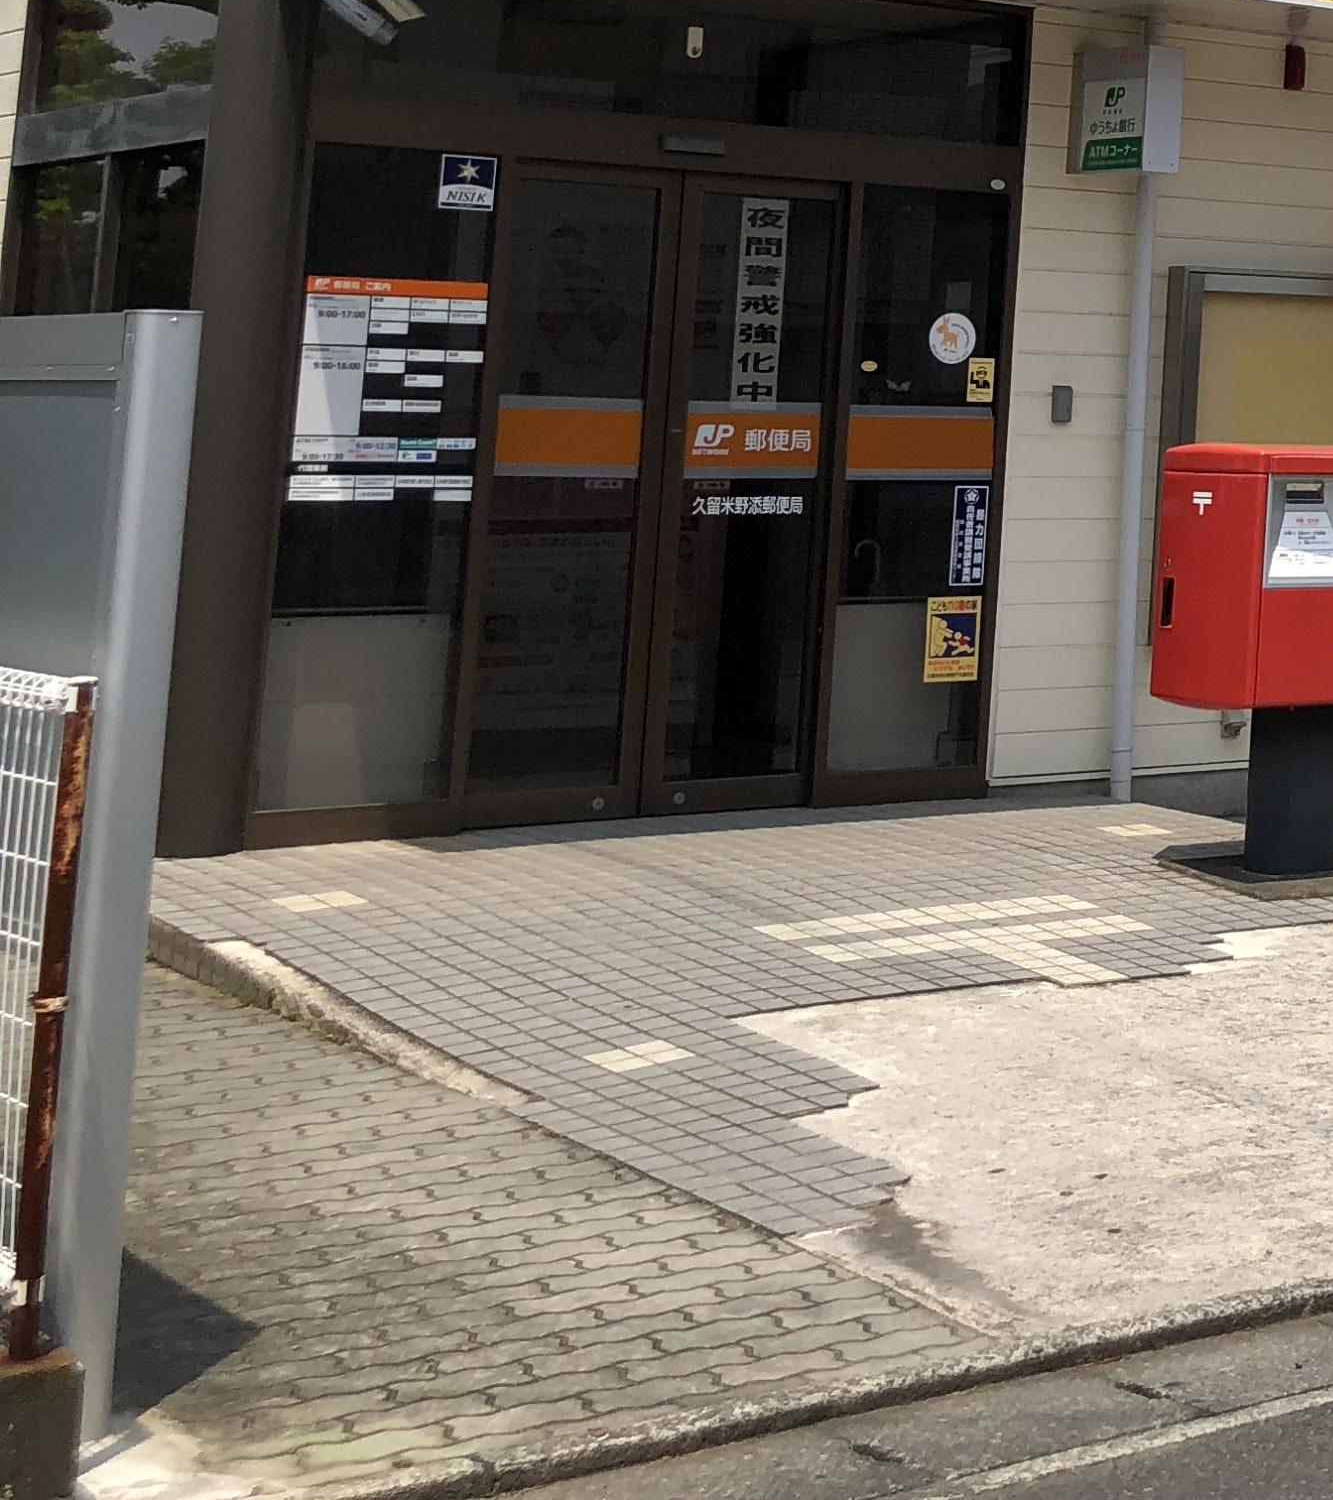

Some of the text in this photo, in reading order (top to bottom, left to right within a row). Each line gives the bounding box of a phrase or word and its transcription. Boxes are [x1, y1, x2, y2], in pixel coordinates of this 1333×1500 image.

[1089, 118, 1136, 135] ゆうちょ銀行
[1089, 143, 1138, 159] ATMコーナー
[737, 207, 786, 403] 夜間警戒強化中
[744, 428, 812, 453] 郵便局
[692, 495, 803, 517] 久留米野添郵便局
